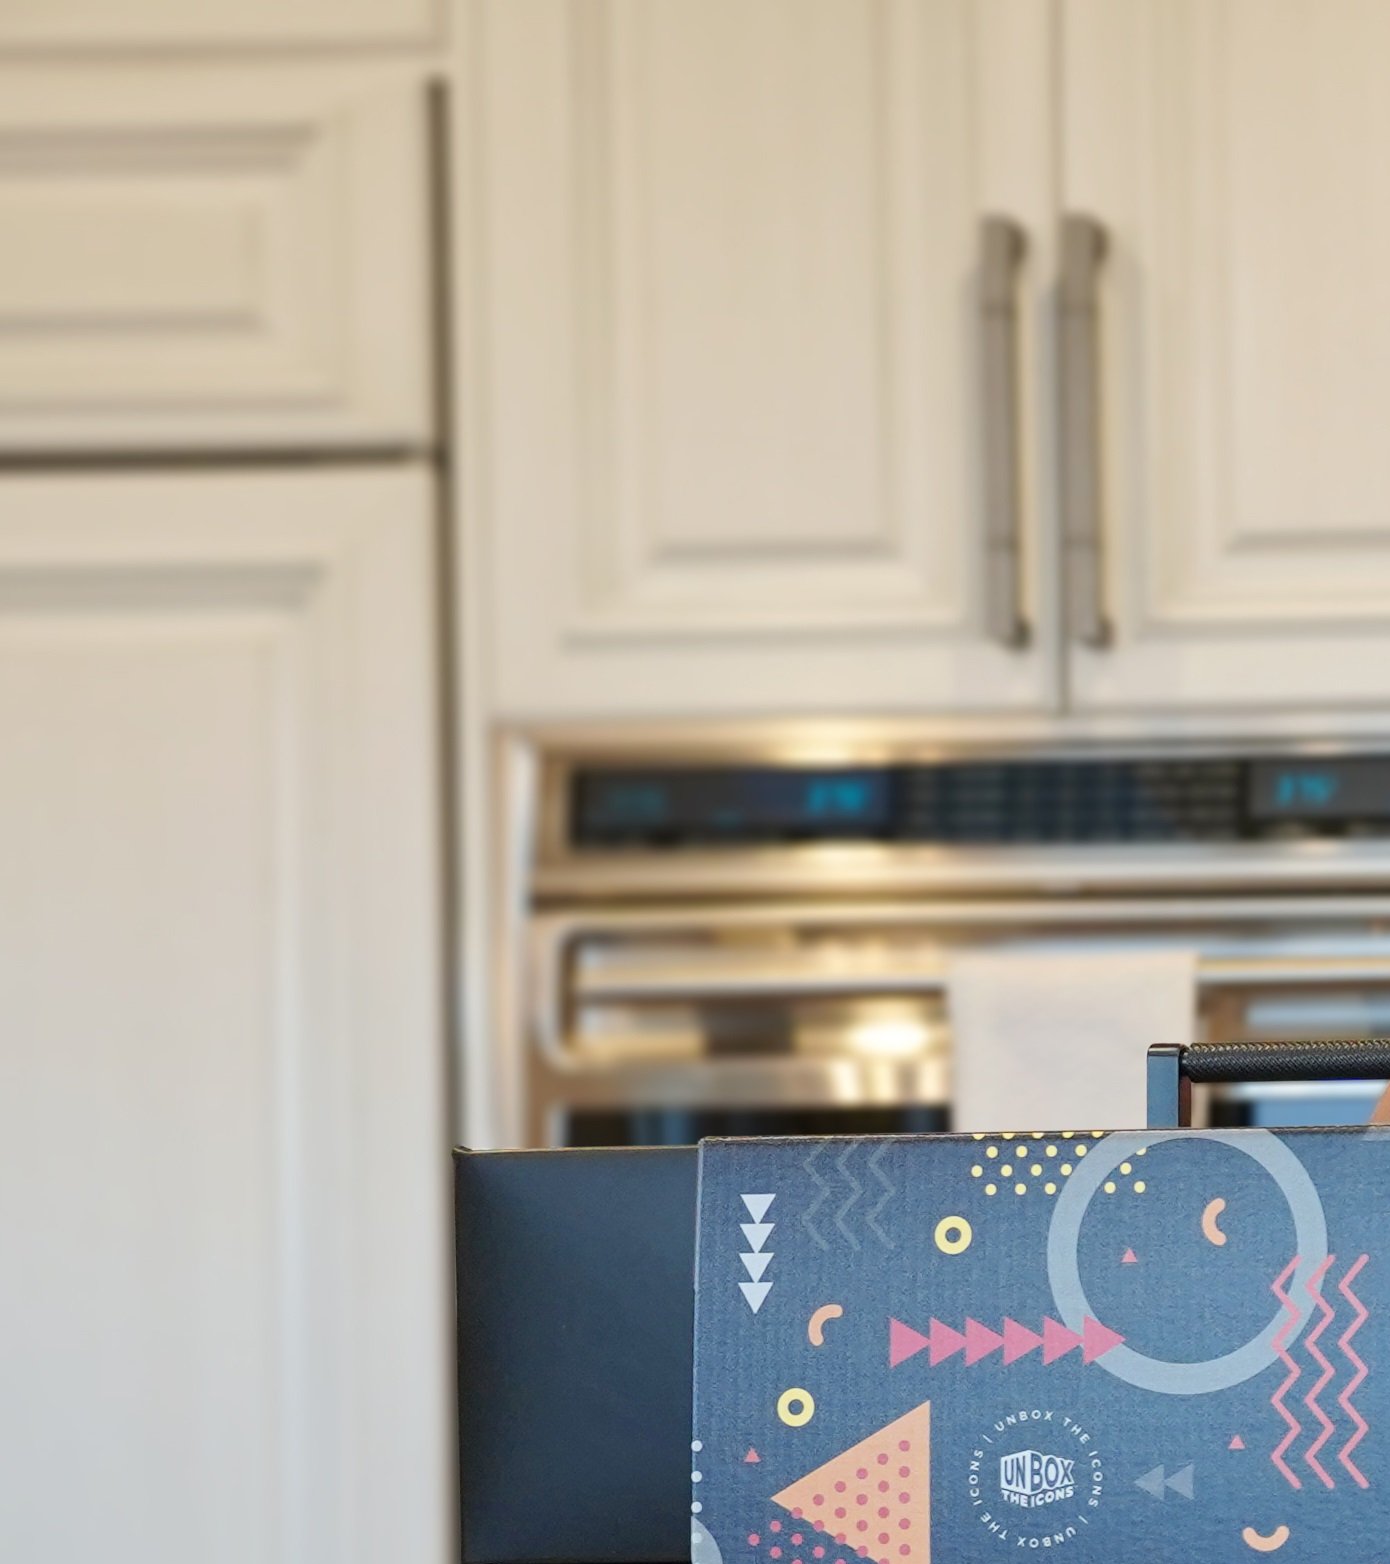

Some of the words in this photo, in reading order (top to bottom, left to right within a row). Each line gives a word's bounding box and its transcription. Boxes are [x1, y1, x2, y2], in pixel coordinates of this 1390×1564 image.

[968, 1448, 984, 1507] ICONS
[994, 1409, 1054, 1433] UNBOX
[1062, 1416, 1090, 1444] THE
[1088, 1450, 1104, 1509] ICONS
[1001, 1450, 1075, 1495] UNBOX
[1001, 1490, 1029, 1509] THE
[1030, 1485, 1075, 1509] ICONS
[980, 1511, 1010, 1541] THE
[1016, 1526, 1077, 1548] UNBOX
